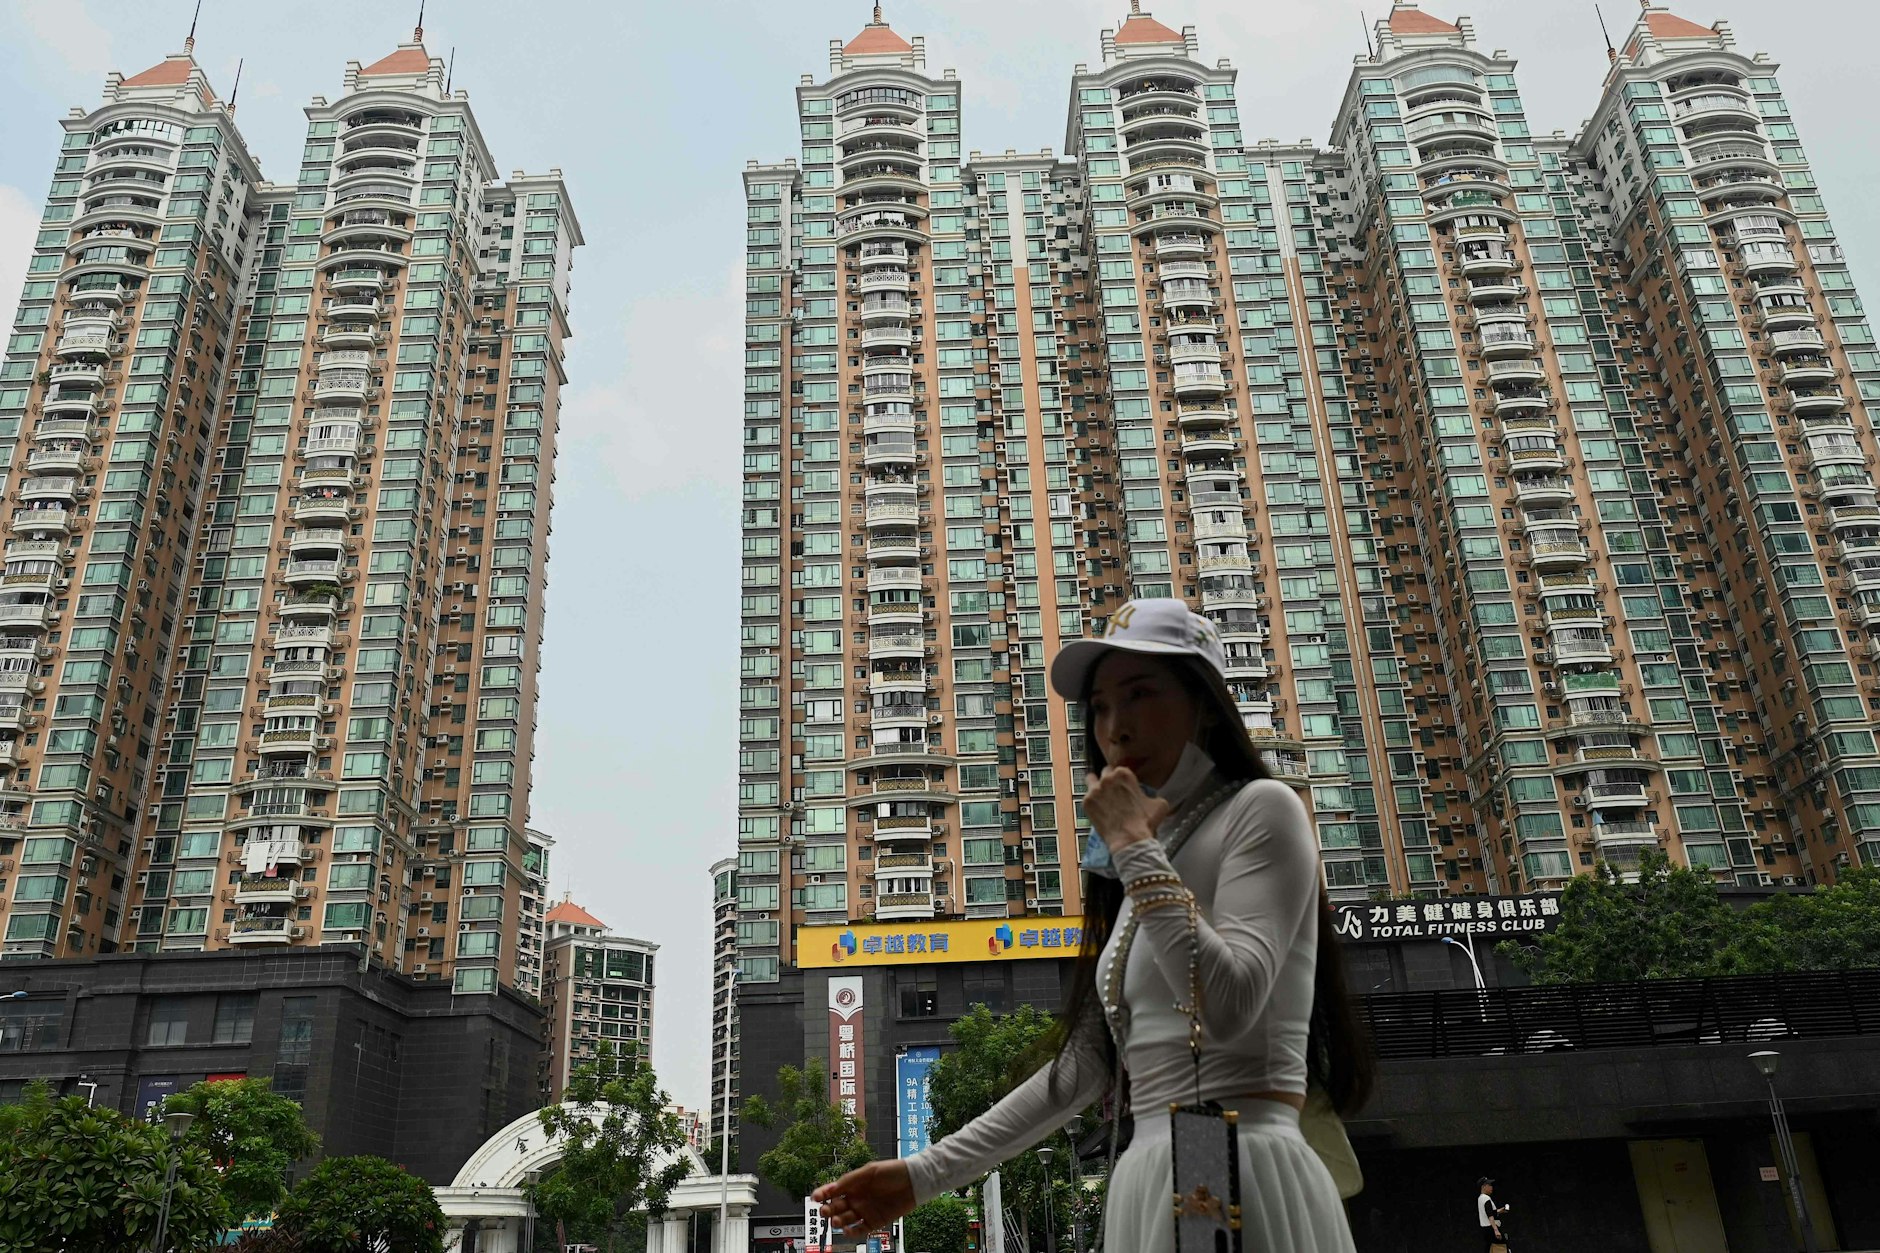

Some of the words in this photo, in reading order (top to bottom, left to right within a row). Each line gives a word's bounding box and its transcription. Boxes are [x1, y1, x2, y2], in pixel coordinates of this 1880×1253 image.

[1019, 927, 1086, 948] 卓越教
[1370, 924, 1423, 938] TOTAL
[1427, 920, 1497, 935] FITNESS
[1501, 918, 1546, 932] CLUB
[862, 932, 949, 954] 卓越教育
[906, 1077, 919, 1157] 9A精工臻筑美
[514, 1136, 529, 1154] 金
[809, 1208, 818, 1244] 健身游泳
